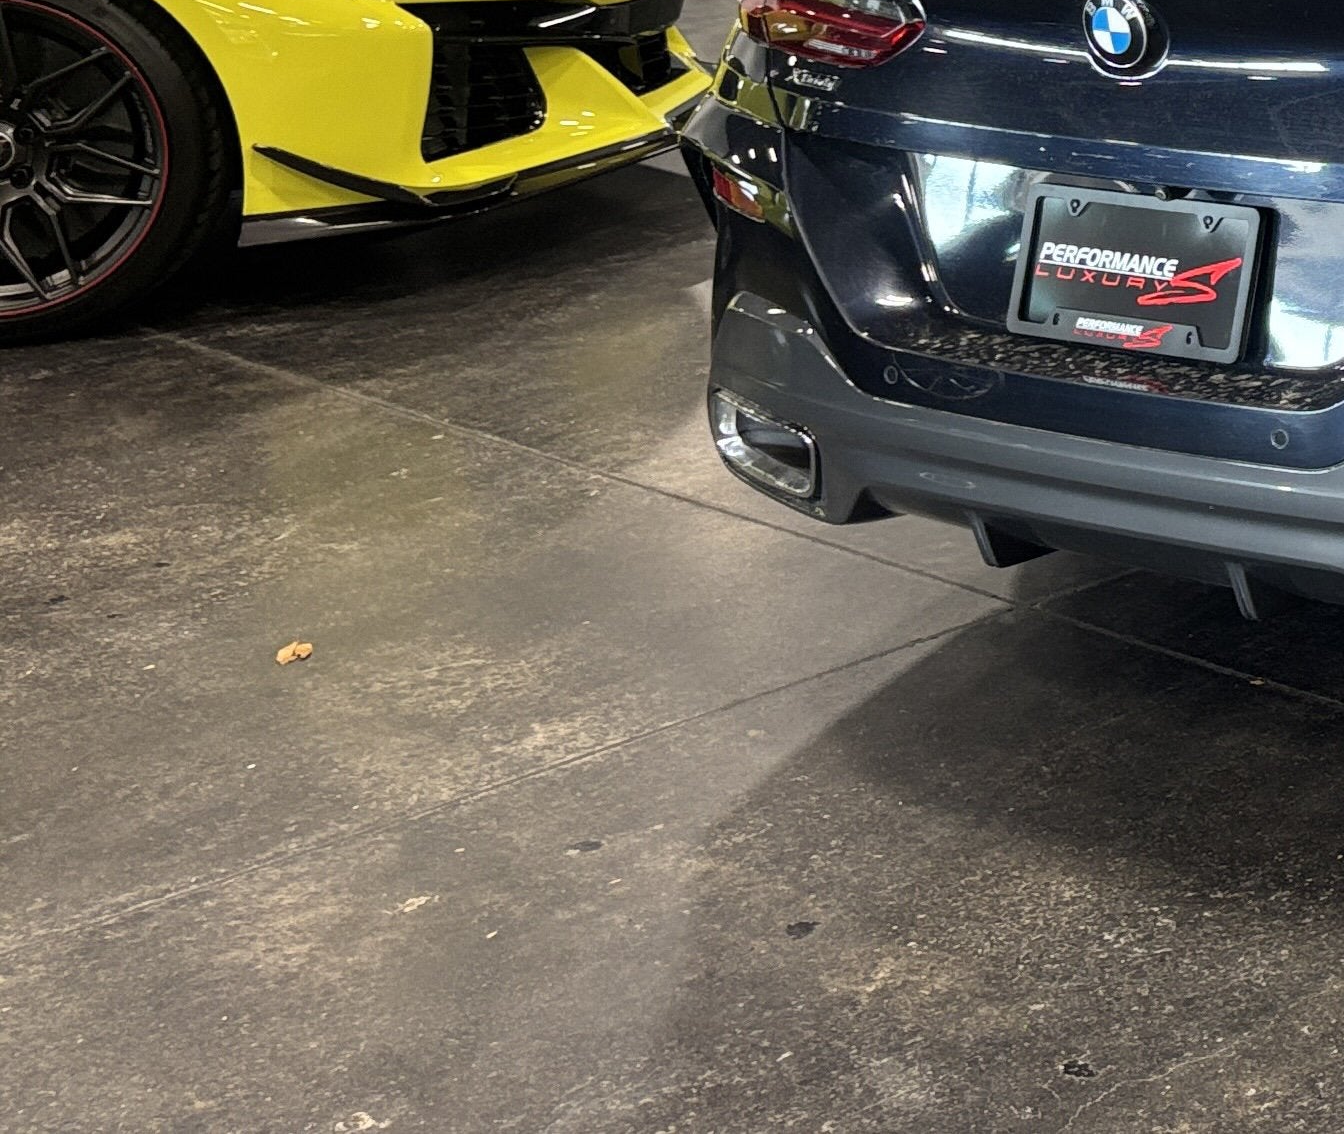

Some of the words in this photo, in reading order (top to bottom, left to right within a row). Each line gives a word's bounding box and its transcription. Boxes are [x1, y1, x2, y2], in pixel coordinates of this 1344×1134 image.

[1039, 242, 1179, 277] PERFORMANCE
[1035, 264, 1169, 291] LUXURY
[1075, 317, 1144, 336] PERFORMANCE
